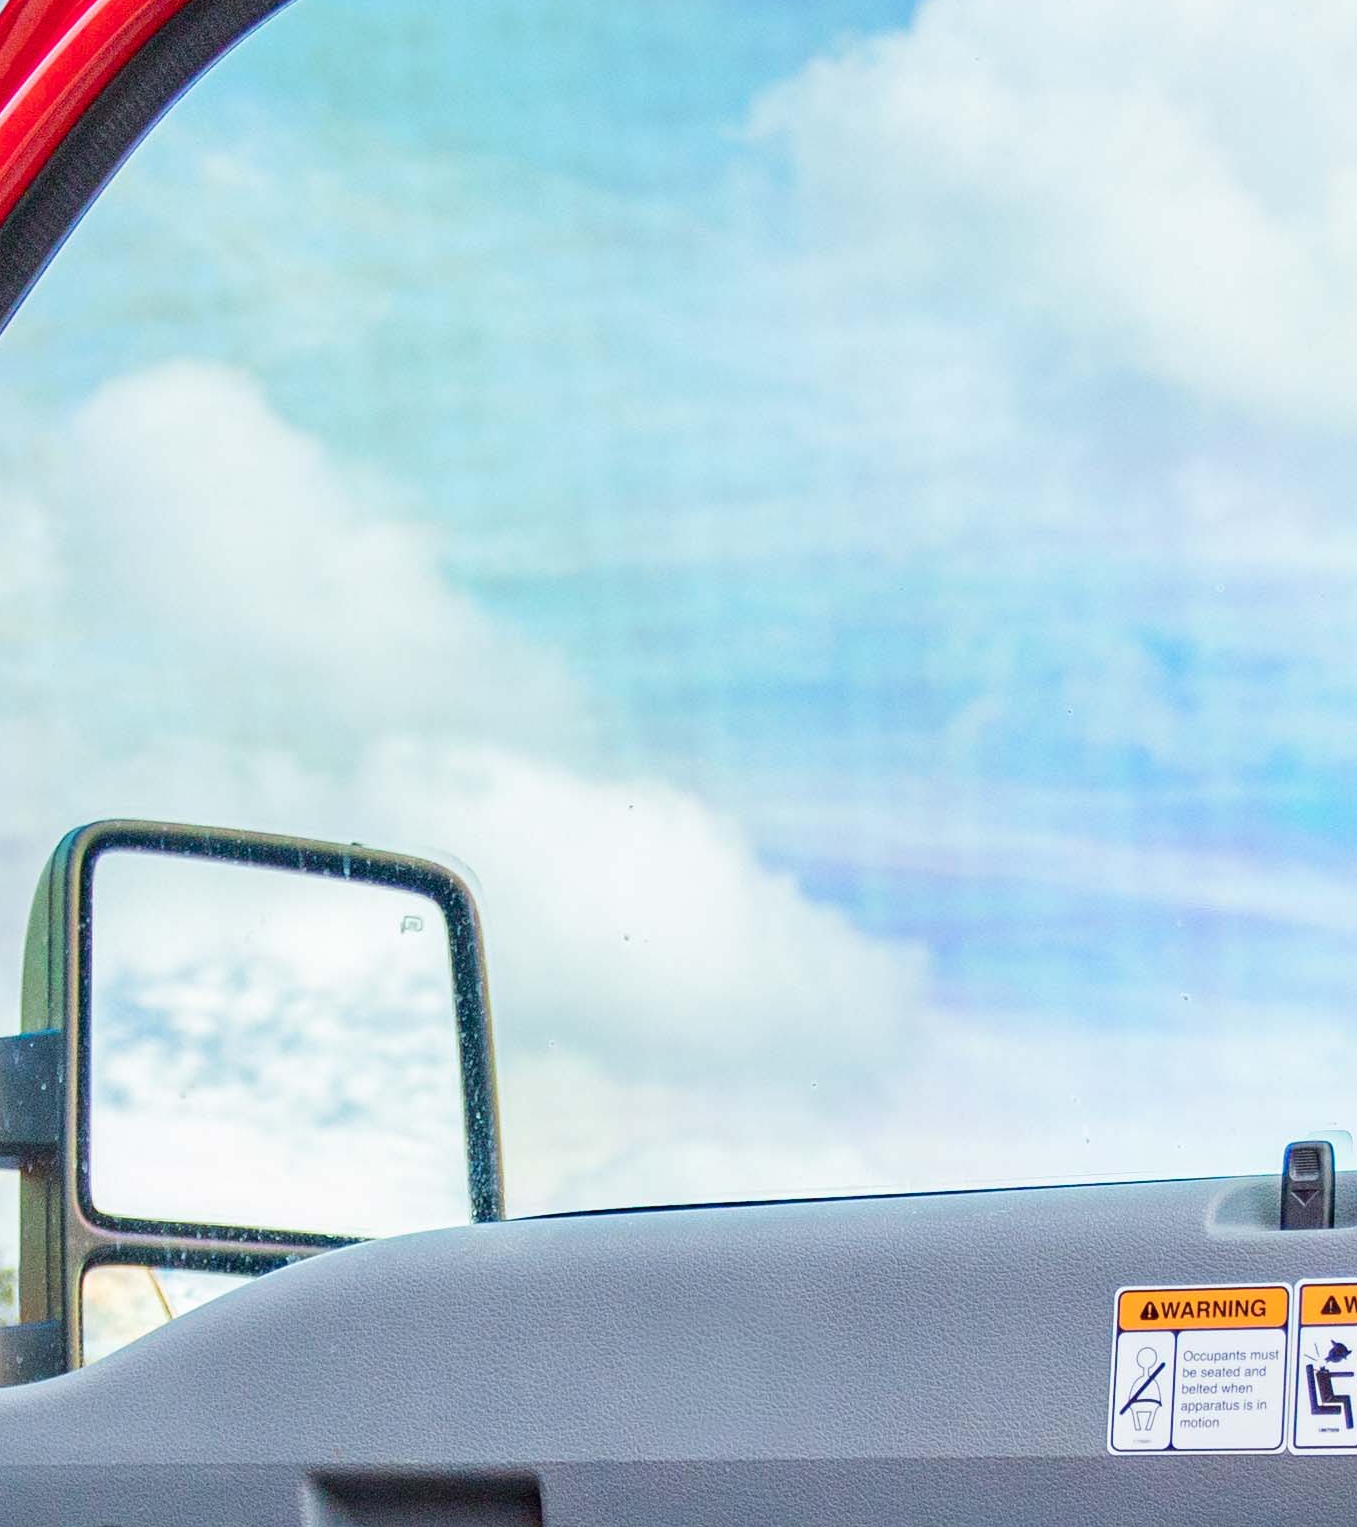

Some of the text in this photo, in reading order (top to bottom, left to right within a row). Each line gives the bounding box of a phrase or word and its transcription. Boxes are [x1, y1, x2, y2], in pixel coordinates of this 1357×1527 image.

[1162, 1299, 1267, 1320] WARNING
[1183, 1350, 1279, 1363] Occupants must
[1182, 1366, 1267, 1378] be seated and
[1182, 1383, 1253, 1394] belted when
[1181, 1400, 1267, 1413] apparatus is in
[1180, 1417, 1219, 1428] motion
